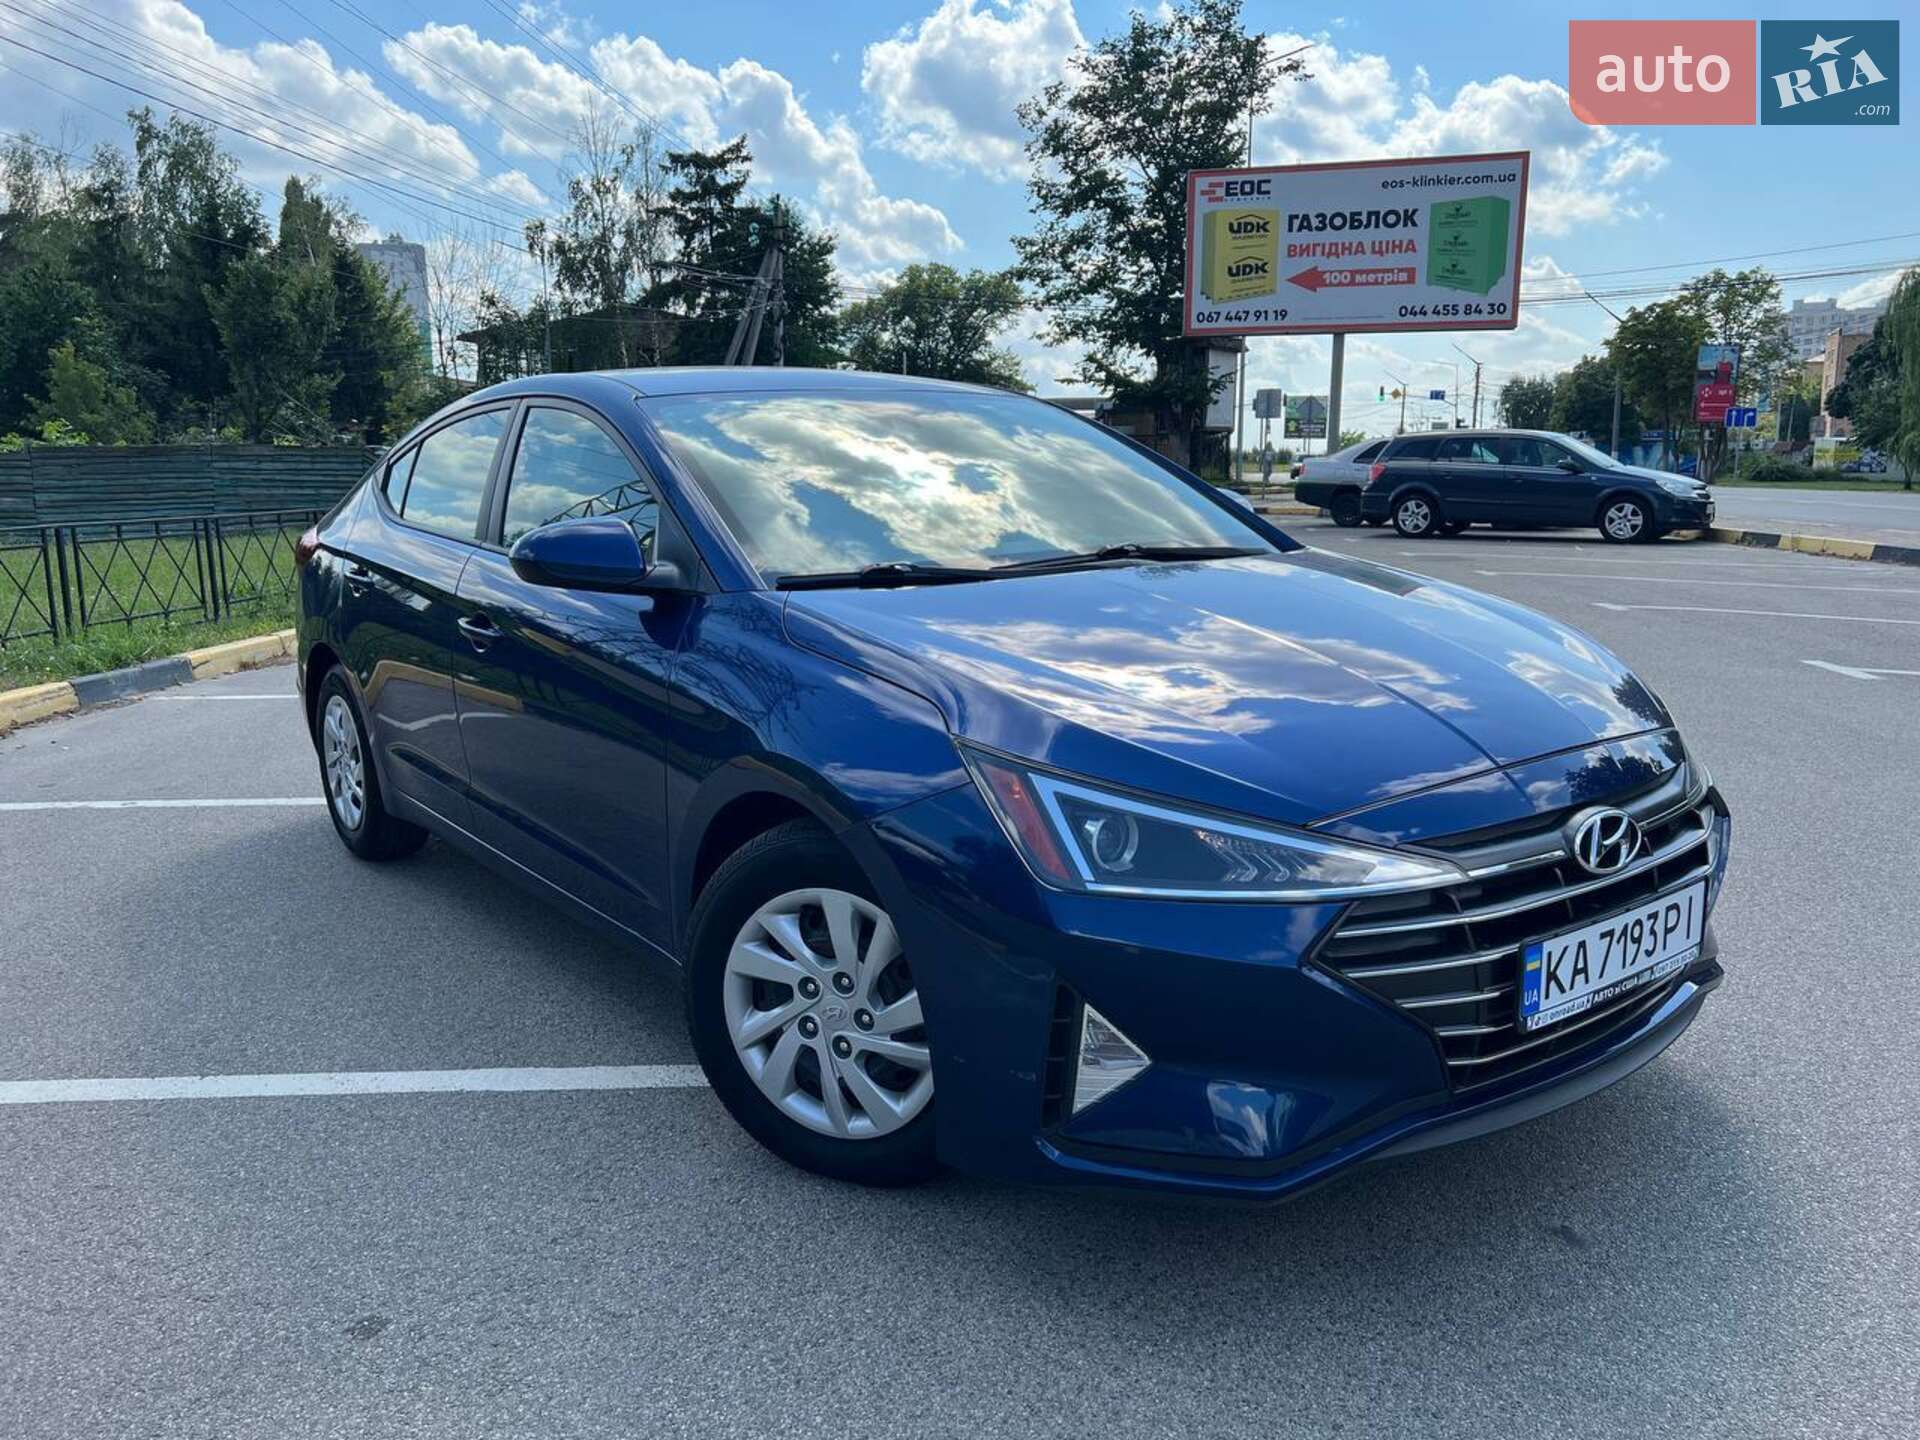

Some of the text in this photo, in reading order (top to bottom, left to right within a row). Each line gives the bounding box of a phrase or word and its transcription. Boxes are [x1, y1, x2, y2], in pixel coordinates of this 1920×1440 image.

[1381, 172, 1516, 189] eos-klinkier.com.ua
[1228, 220, 1271, 234] UDK
[1287, 208, 1419, 232] ГАЗОБЛОК
[1287, 241, 1365, 259] ВИГІДНА
[1371, 239, 1417, 257] ЦІНА
[1227, 262, 1269, 277] UDK
[1322, 268, 1408, 284] 100 метрів
[1196, 311, 1221, 323] 067
[1225, 310, 1250, 322] 447
[1253, 309, 1269, 322] 91
[1272, 308, 1288, 321] 19
[1399, 302, 1507, 317] 044 455 84 30
[1525, 989, 1538, 1005] UA
